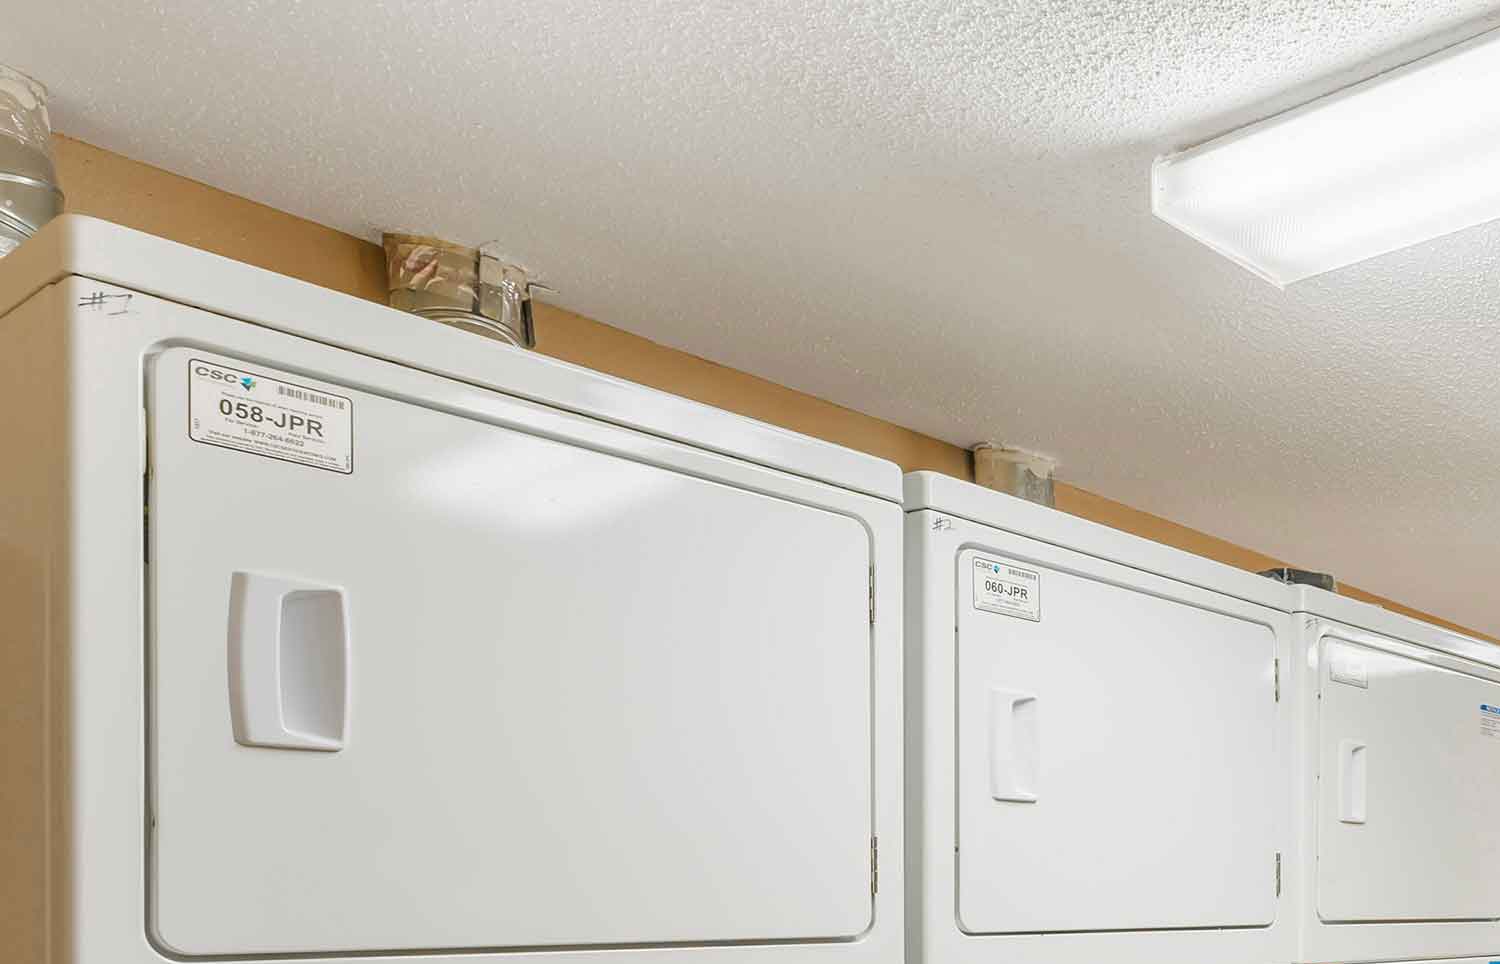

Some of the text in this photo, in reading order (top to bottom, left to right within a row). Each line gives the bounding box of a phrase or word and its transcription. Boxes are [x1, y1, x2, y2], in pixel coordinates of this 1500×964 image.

[195, 366, 237, 384] CSC
[219, 398, 324, 438] 058-JPR
[975, 561, 992, 571] CSC
[985, 580, 1028, 600] 060-JPR
